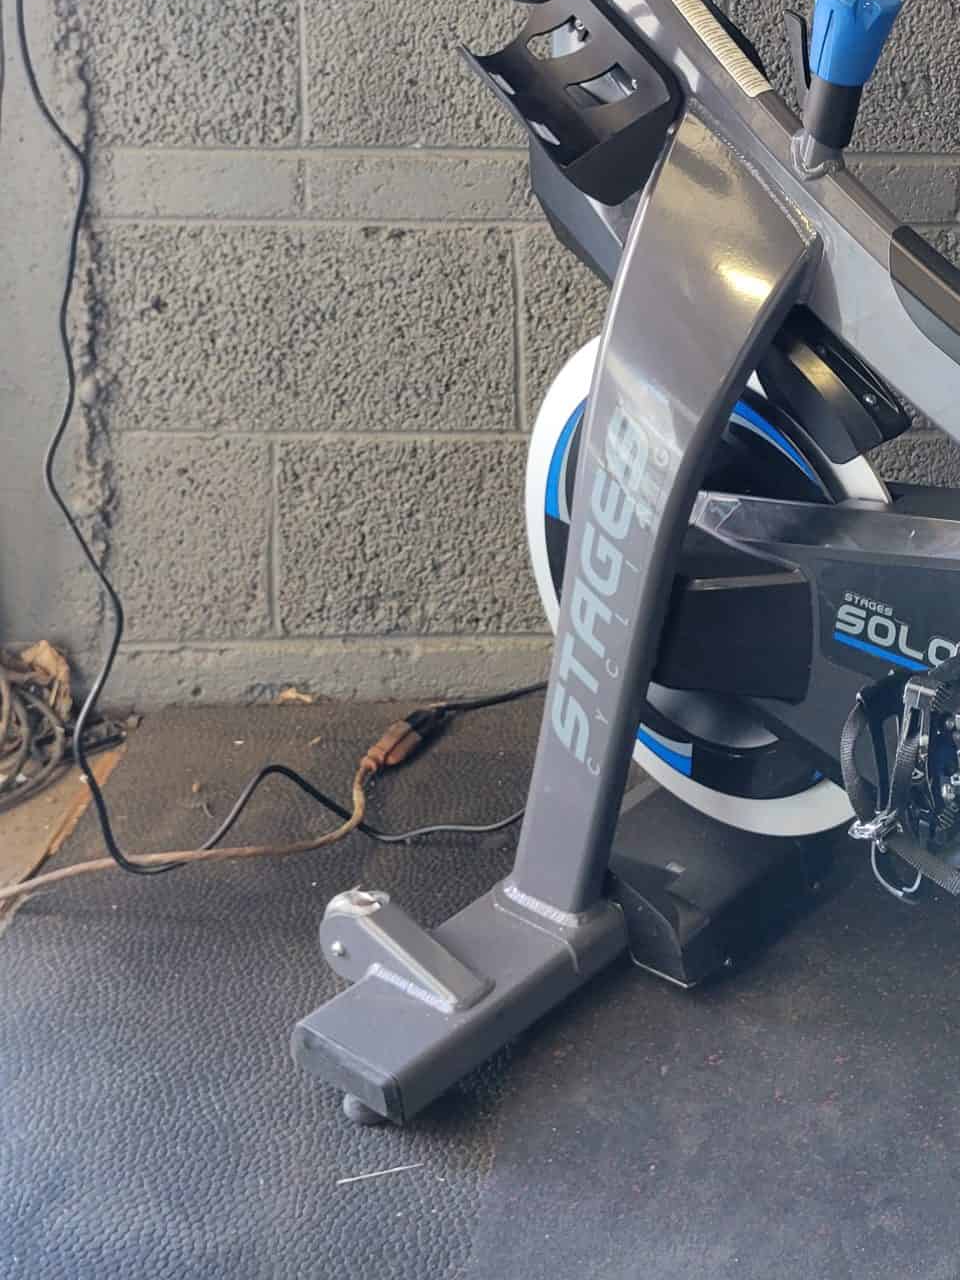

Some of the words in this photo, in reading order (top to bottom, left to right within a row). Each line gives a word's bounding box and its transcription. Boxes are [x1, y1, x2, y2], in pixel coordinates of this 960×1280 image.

[552, 410, 648, 765] STAGES
[844, 592, 893, 617] STAGES
[835, 604, 957, 668] SOLO
